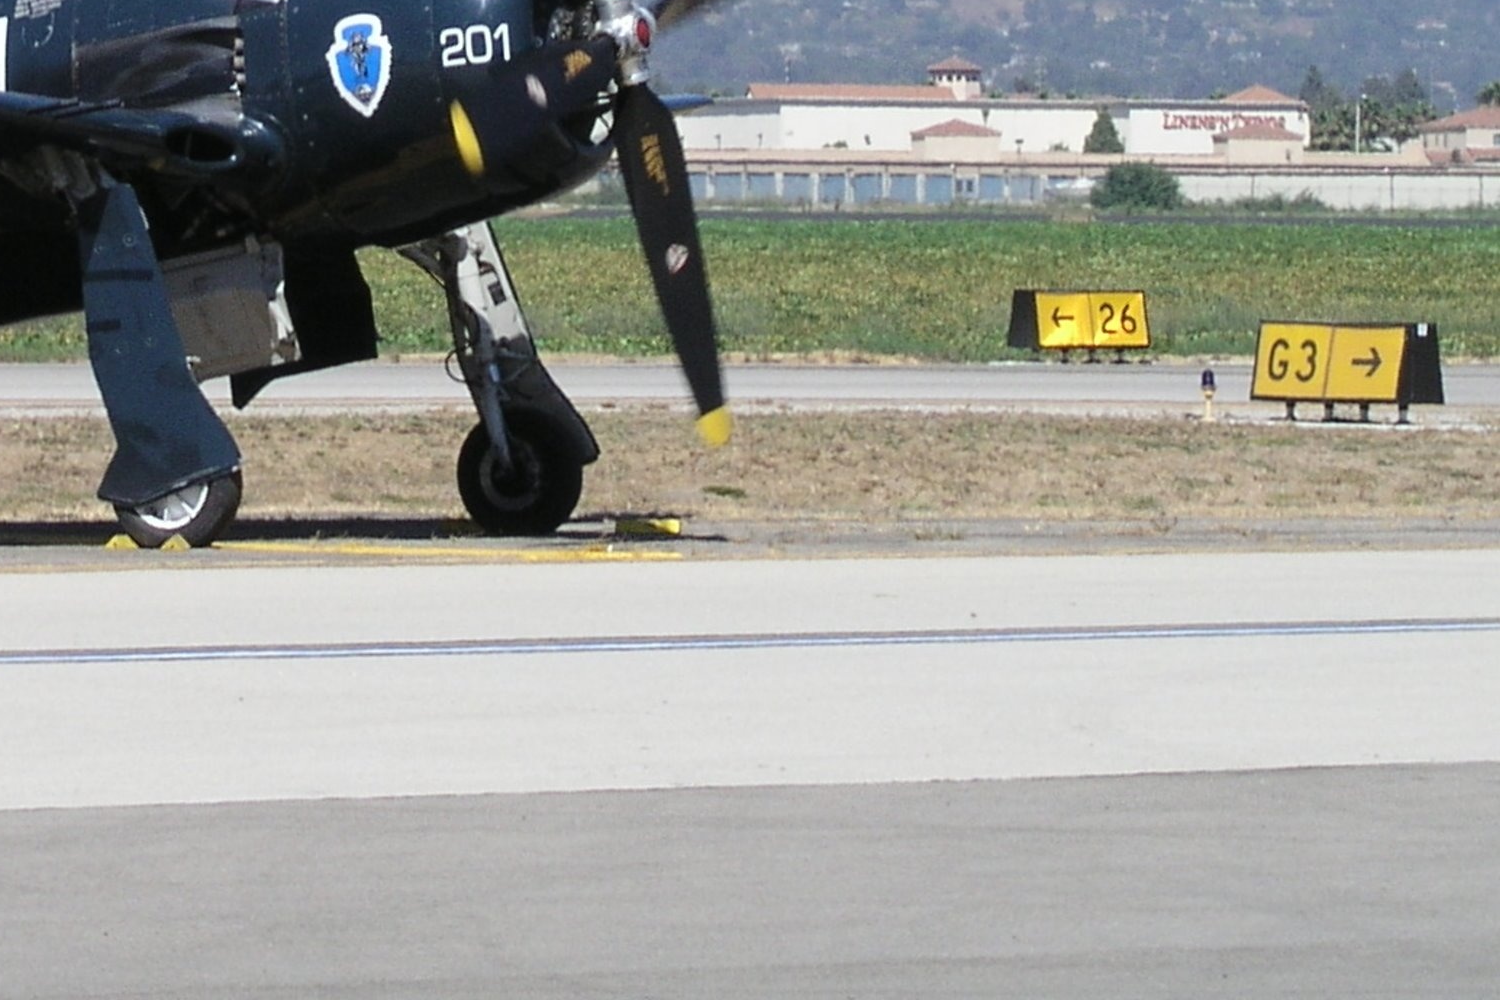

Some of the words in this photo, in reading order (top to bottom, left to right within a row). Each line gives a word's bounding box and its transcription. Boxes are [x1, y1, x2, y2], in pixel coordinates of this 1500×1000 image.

[440, 22, 511, 67] 201
[1100, 303, 1137, 335] 26
[1268, 338, 1317, 382] G3
